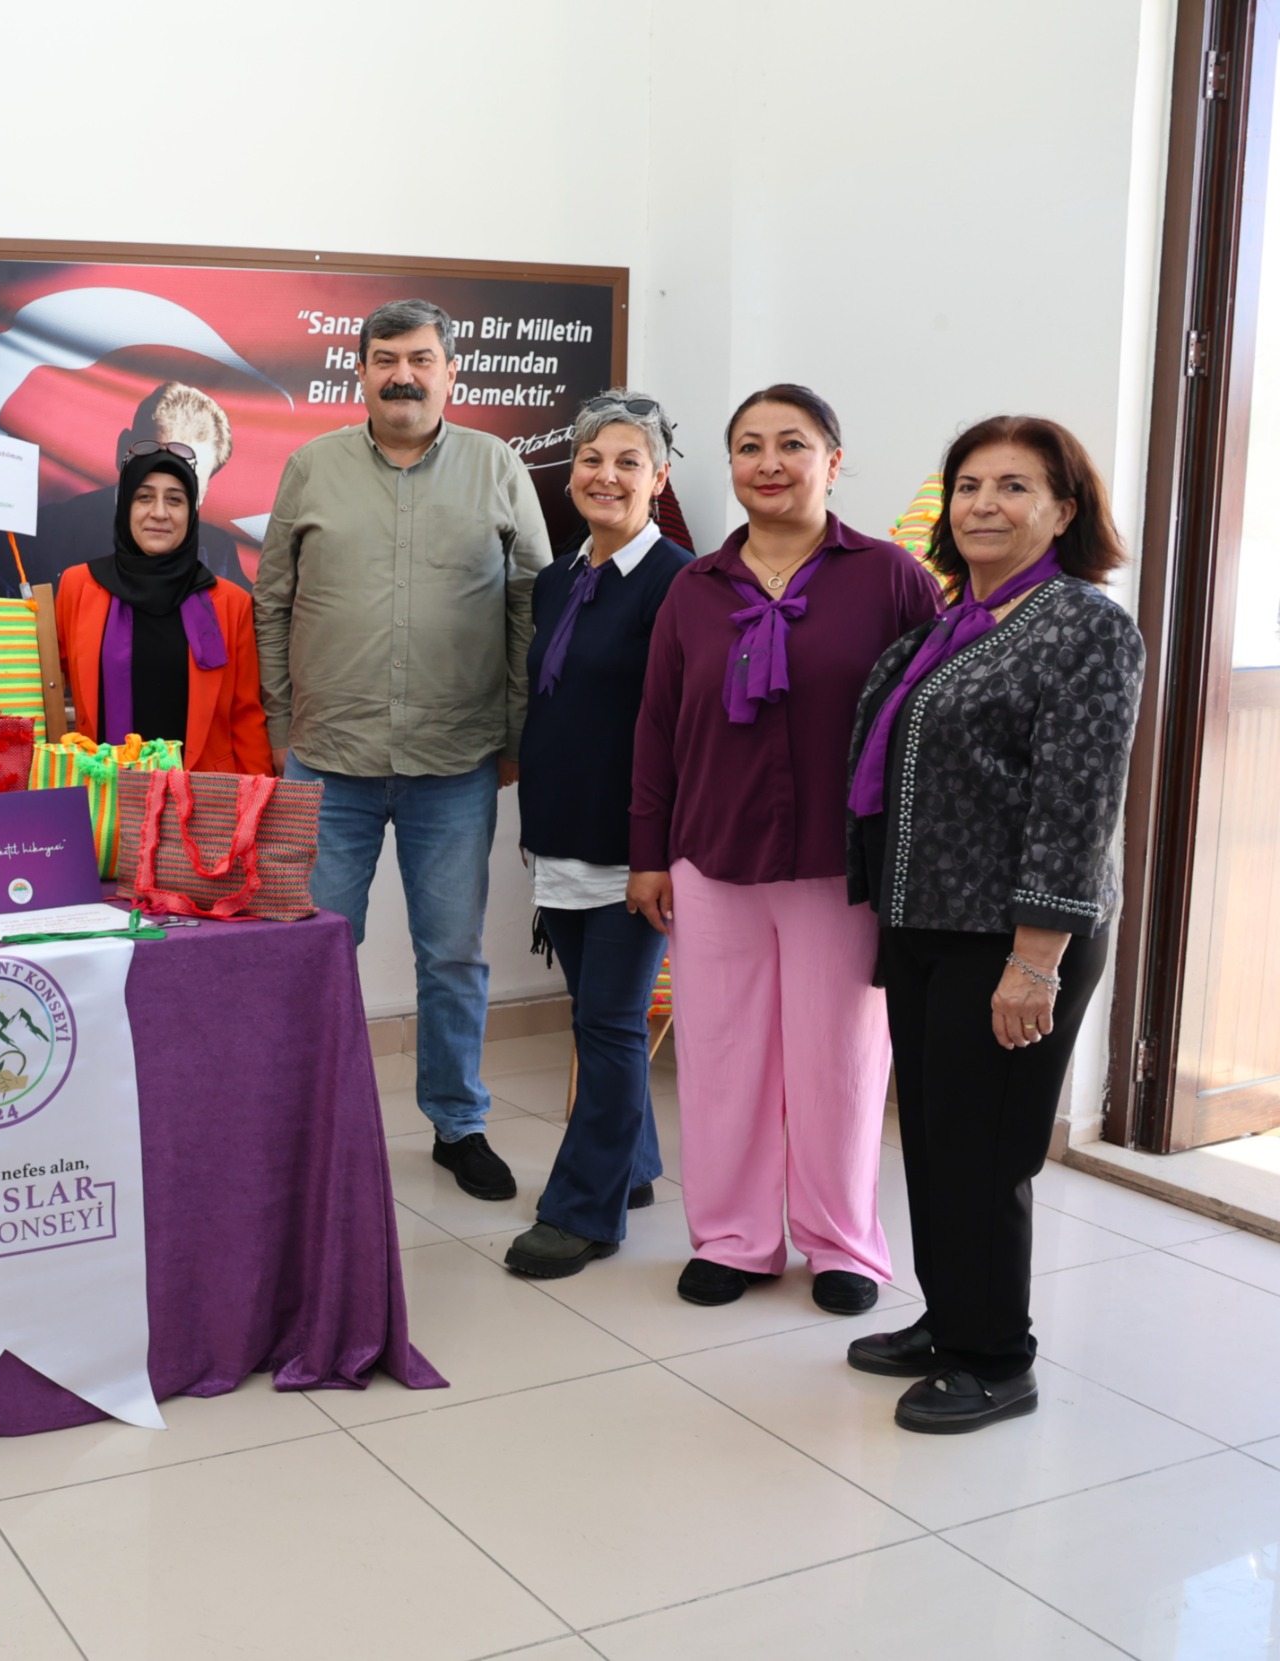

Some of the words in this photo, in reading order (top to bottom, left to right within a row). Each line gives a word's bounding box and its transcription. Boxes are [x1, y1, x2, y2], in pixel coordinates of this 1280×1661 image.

[297, 310, 364, 336] “Sana
[480, 316, 513, 340] Bir
[516, 318, 593, 343] Milletin
[454, 349, 559, 374] arlarından
[307, 380, 349, 404] Biri
[24, 970, 72, 1042] KONSEYİ
[1, 1163, 46, 1181] nefes
[50, 1158, 90, 1175] alan,
